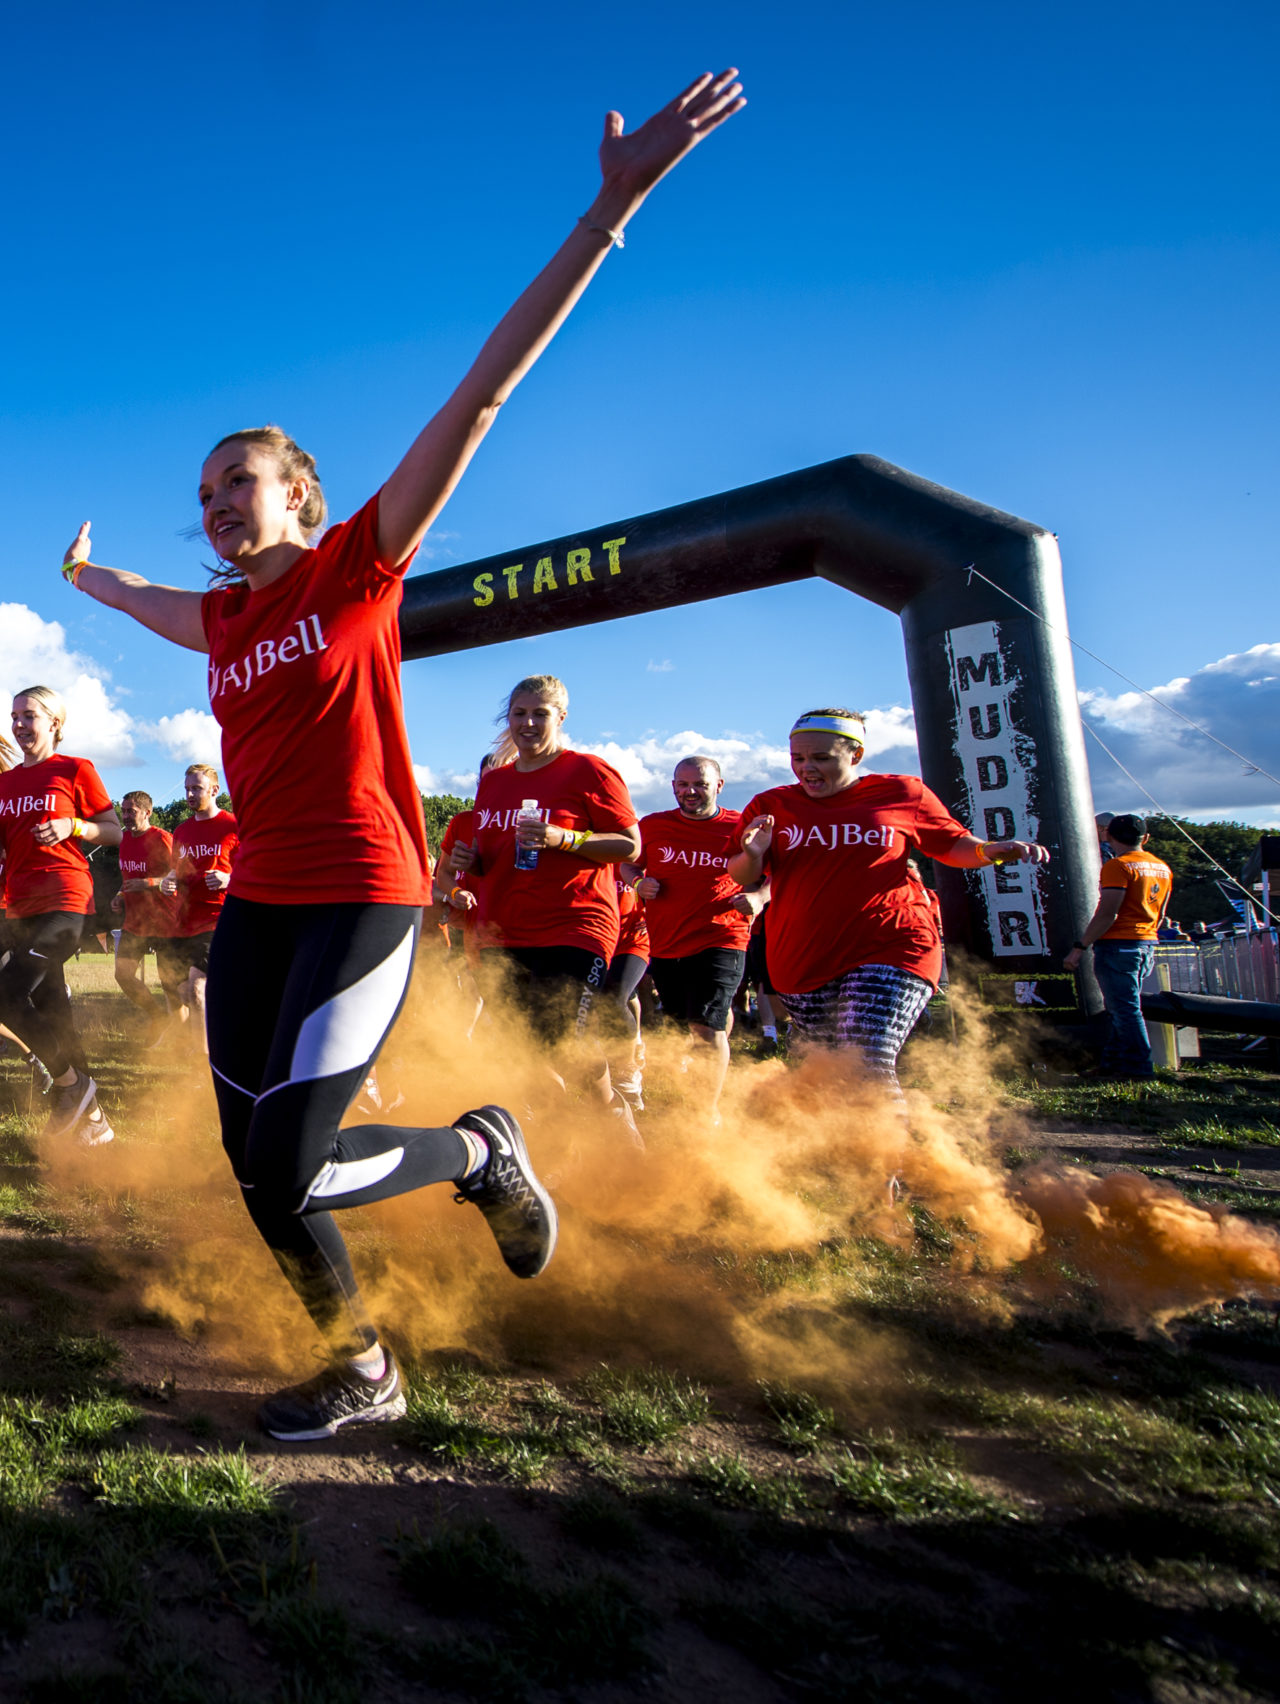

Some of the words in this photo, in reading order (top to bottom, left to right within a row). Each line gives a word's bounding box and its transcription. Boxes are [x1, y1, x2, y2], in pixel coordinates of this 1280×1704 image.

[473, 537, 626, 606] START
[488, 808, 551, 831] AJBl
[957, 653, 1035, 947] MUDDER
